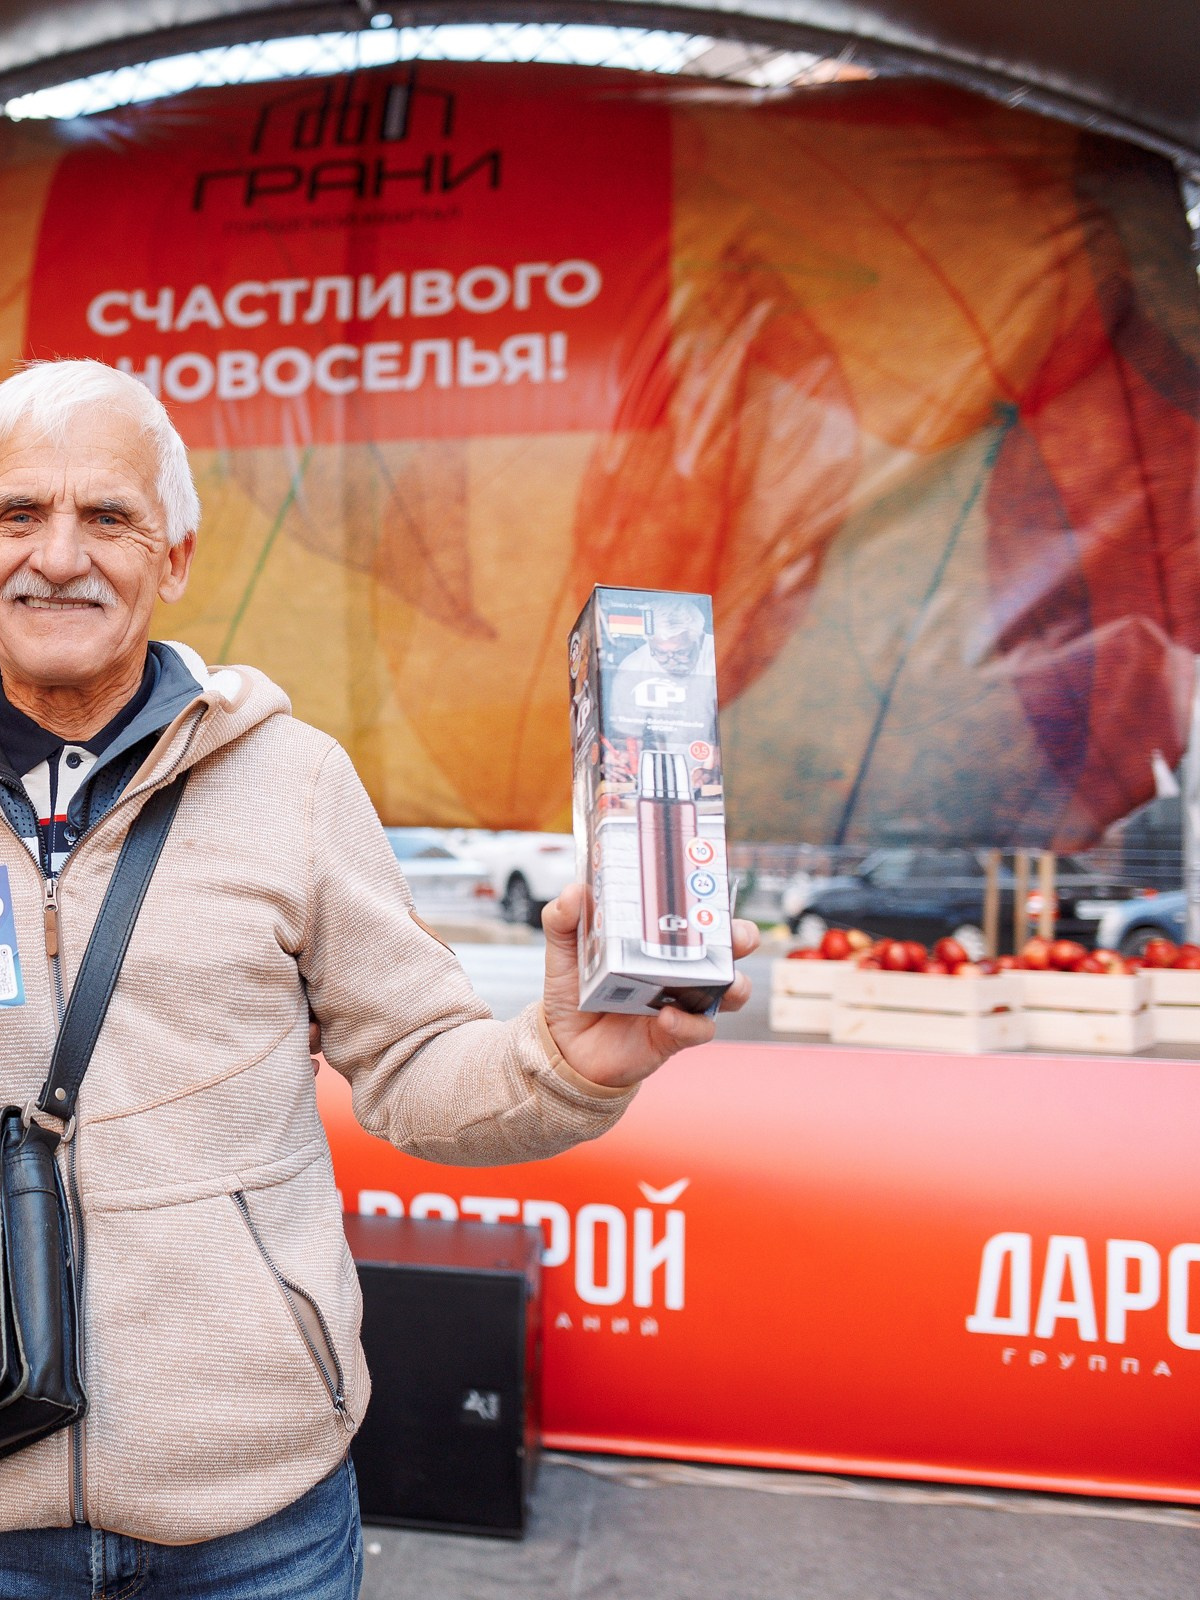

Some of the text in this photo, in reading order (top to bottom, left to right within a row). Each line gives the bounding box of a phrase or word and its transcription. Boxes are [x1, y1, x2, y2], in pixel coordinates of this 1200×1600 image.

[191, 148, 501, 213] ГРАНИ
[86, 259, 601, 336] СЧАСТЛИВОГО
[555, 1312, 659, 1337] АНИЙ
[1001, 1347, 1173, 1378] ГРУППА
